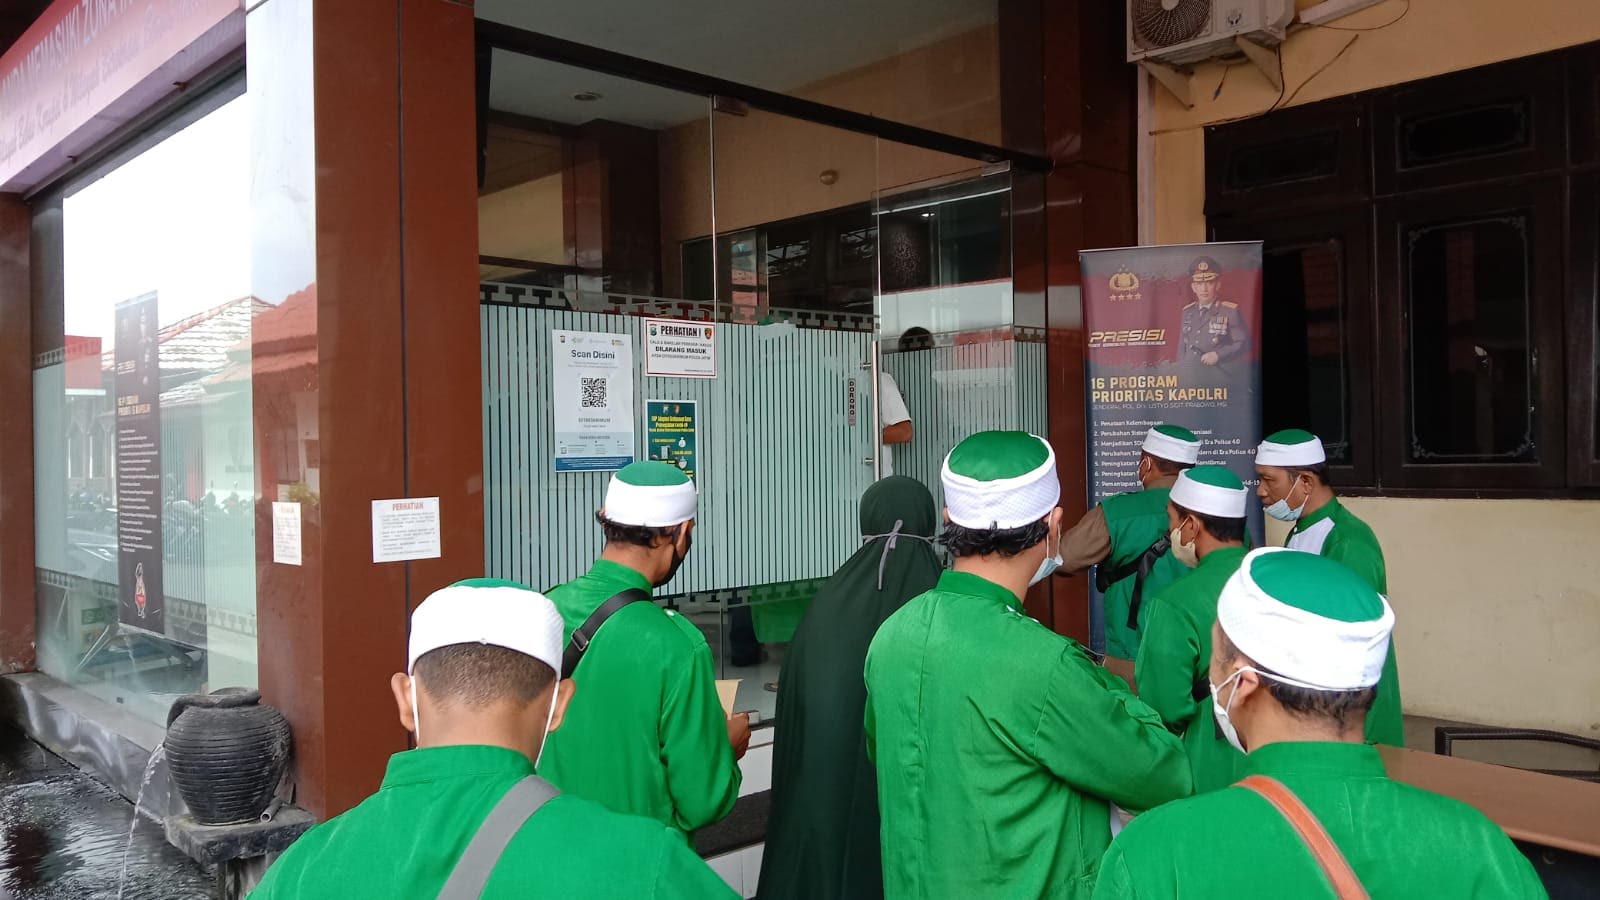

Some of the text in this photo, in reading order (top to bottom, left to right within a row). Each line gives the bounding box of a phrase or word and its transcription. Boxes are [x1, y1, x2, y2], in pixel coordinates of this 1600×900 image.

[660, 326, 697, 336] PERHATIAN
[1089, 329, 1165, 343] PRESISI
[571, 350, 615, 359] Scan Disini
[1091, 375, 1178, 390] 16 PROGRAM
[1092, 387, 1228, 403] PRIORITAS KAPOLRI
